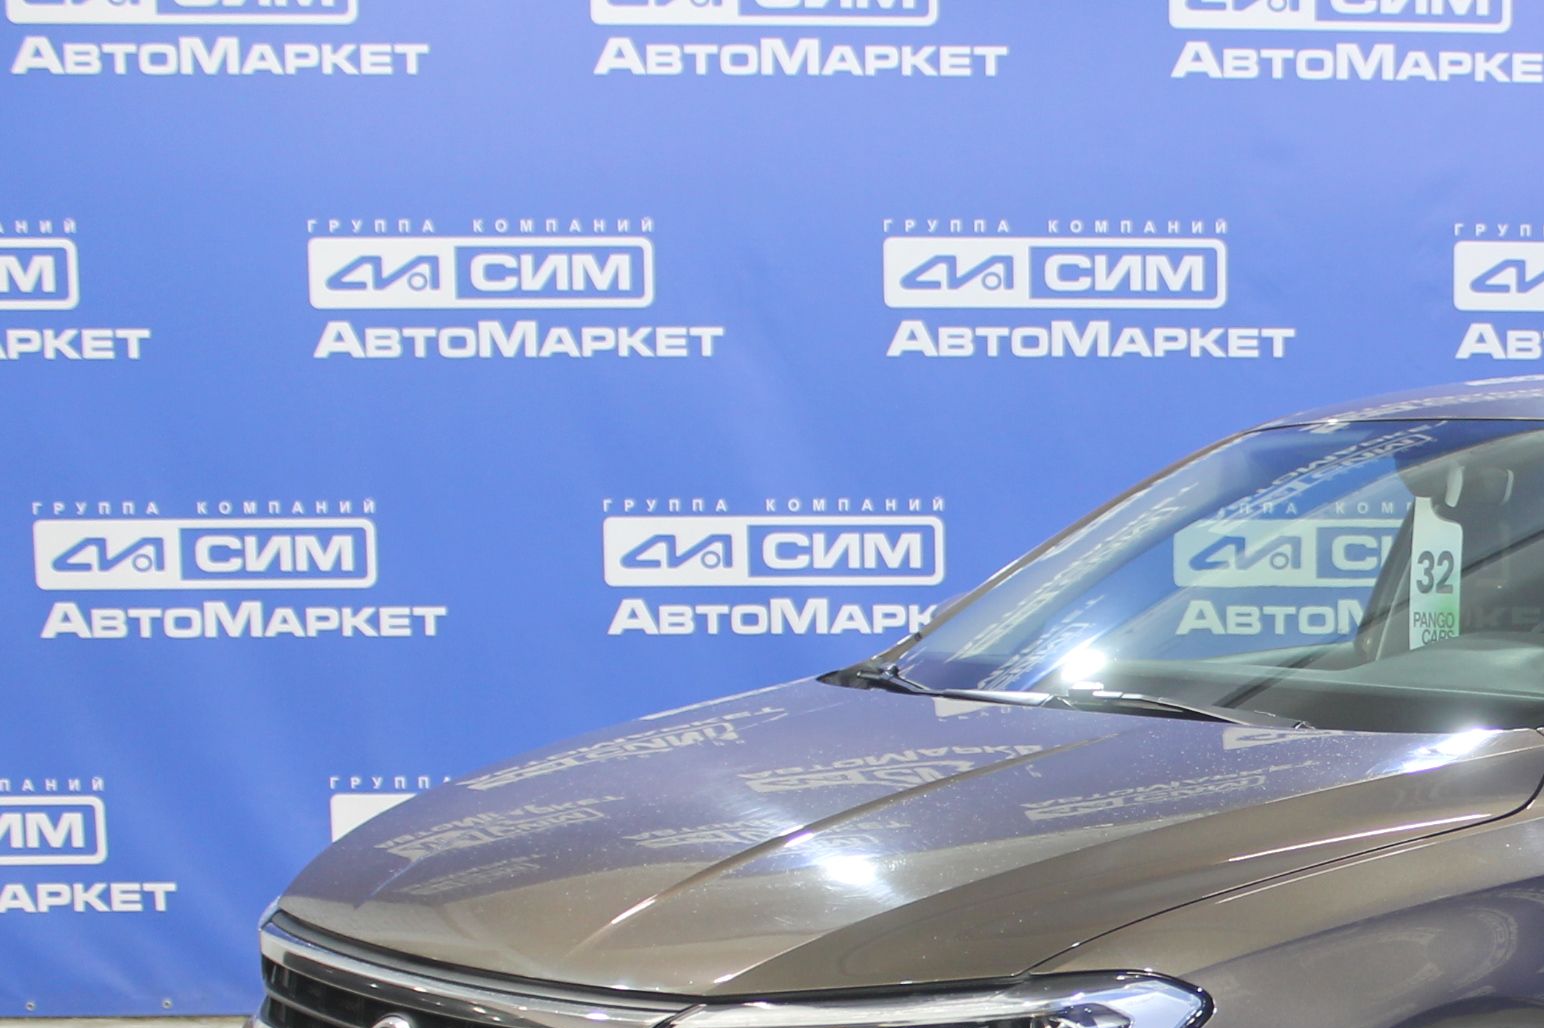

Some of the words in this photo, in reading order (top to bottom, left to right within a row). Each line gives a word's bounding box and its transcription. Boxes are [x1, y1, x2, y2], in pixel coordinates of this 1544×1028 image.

[306, 218, 434, 233] ГРУППА
[472, 216, 654, 233] КОМПАНИЙ
[883, 218, 1010, 233] ГРУППА
[1047, 217, 1228, 235] КОМПАНИЙ
[469, 253, 631, 291] СИМ
[1044, 253, 1205, 292] СИМ
[31, 500, 160, 515] ГРУППА
[196, 498, 377, 515] КОМПАНИЙ
[602, 498, 728, 513] ГРУППА
[765, 496, 944, 513] КОМПАНИЙ
[194, 534, 354, 573] СИМ
[762, 532, 923, 569] СИМ
[1416, 550, 1454, 595] 32
[1413, 611, 1456, 629] PANGO
